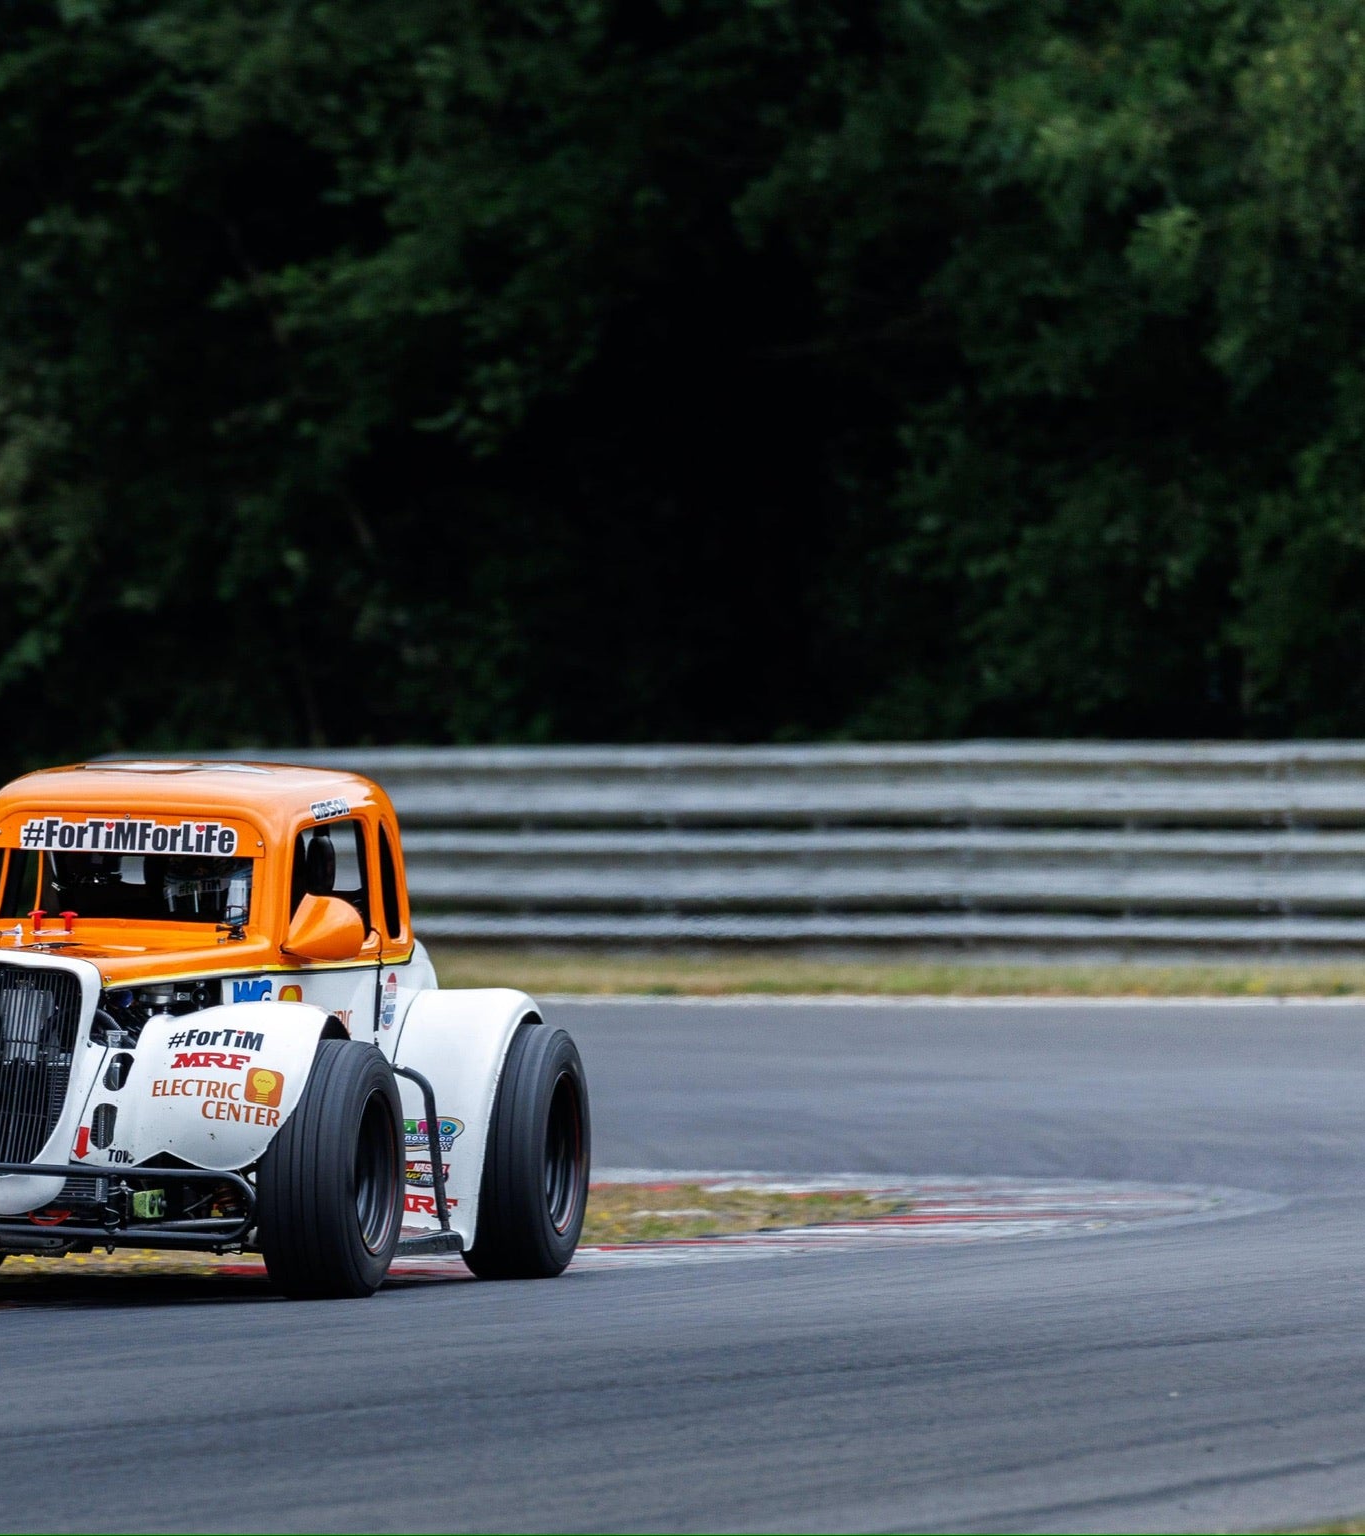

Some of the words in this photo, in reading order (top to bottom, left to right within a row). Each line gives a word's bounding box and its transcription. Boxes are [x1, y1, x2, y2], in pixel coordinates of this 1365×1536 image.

[23, 820, 235, 853] #ForTiMForLiFe
[167, 1029, 265, 1052] #ForTiM
[170, 1052, 251, 1071] MRF
[151, 1078, 242, 1101] ELECTRIC
[201, 1100, 281, 1128] CENTER
